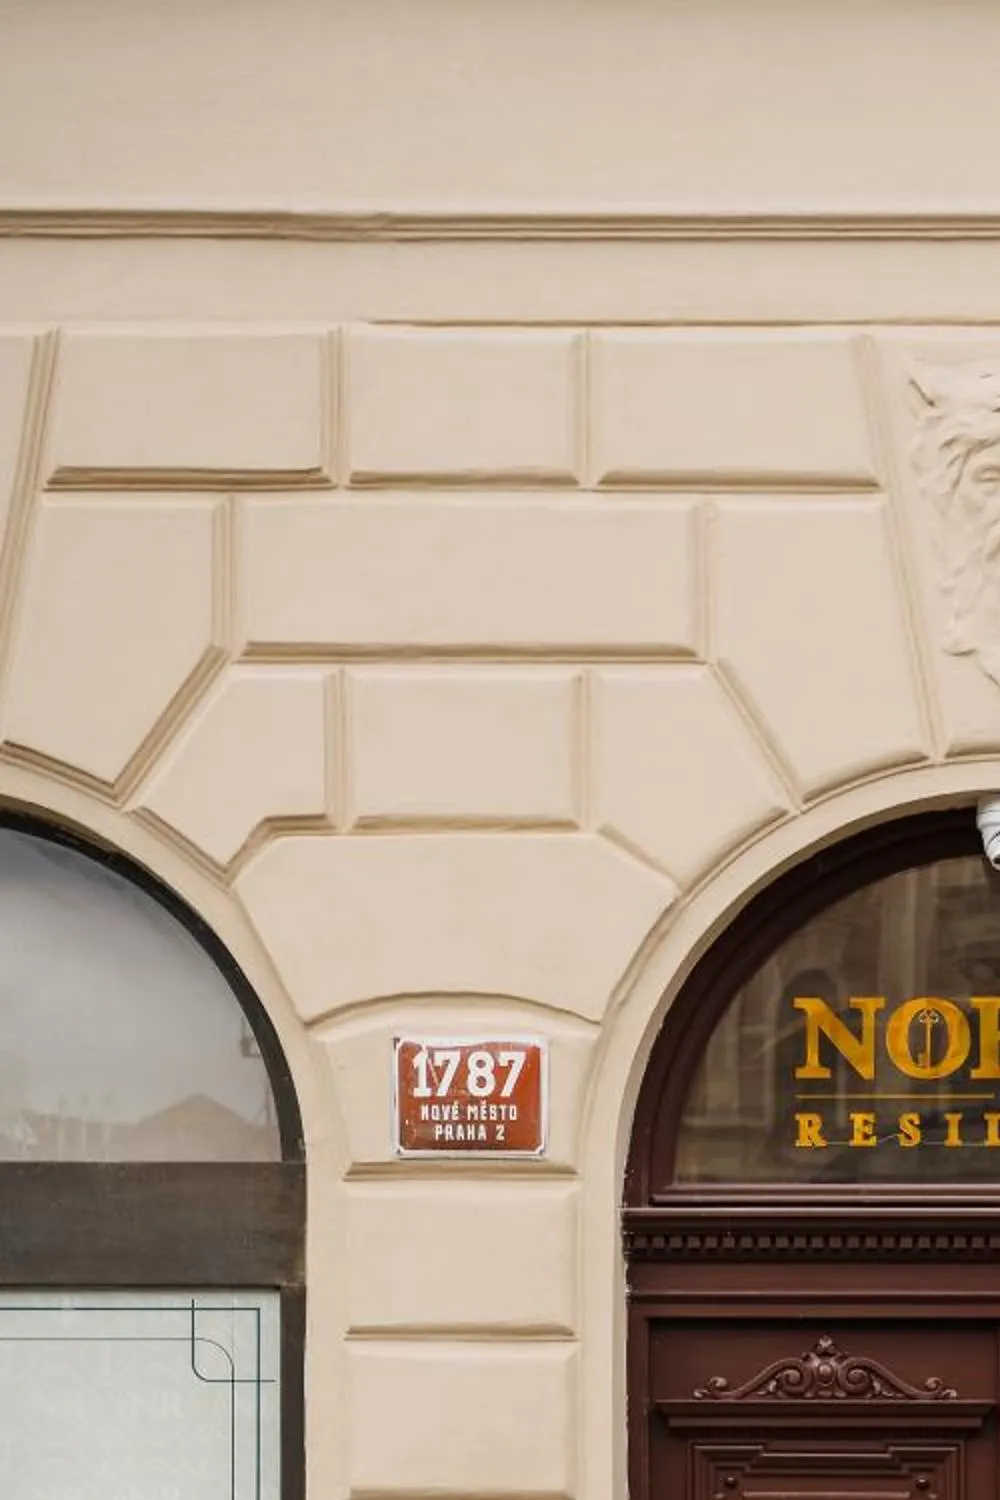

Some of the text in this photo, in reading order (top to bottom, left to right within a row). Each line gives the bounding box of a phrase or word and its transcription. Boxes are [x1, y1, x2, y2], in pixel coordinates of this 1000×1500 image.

[412, 1050, 526, 1097] 1787
[421, 1101, 459, 1120] NOVÉ
[435, 1124, 505, 1141] PRAHA 2
